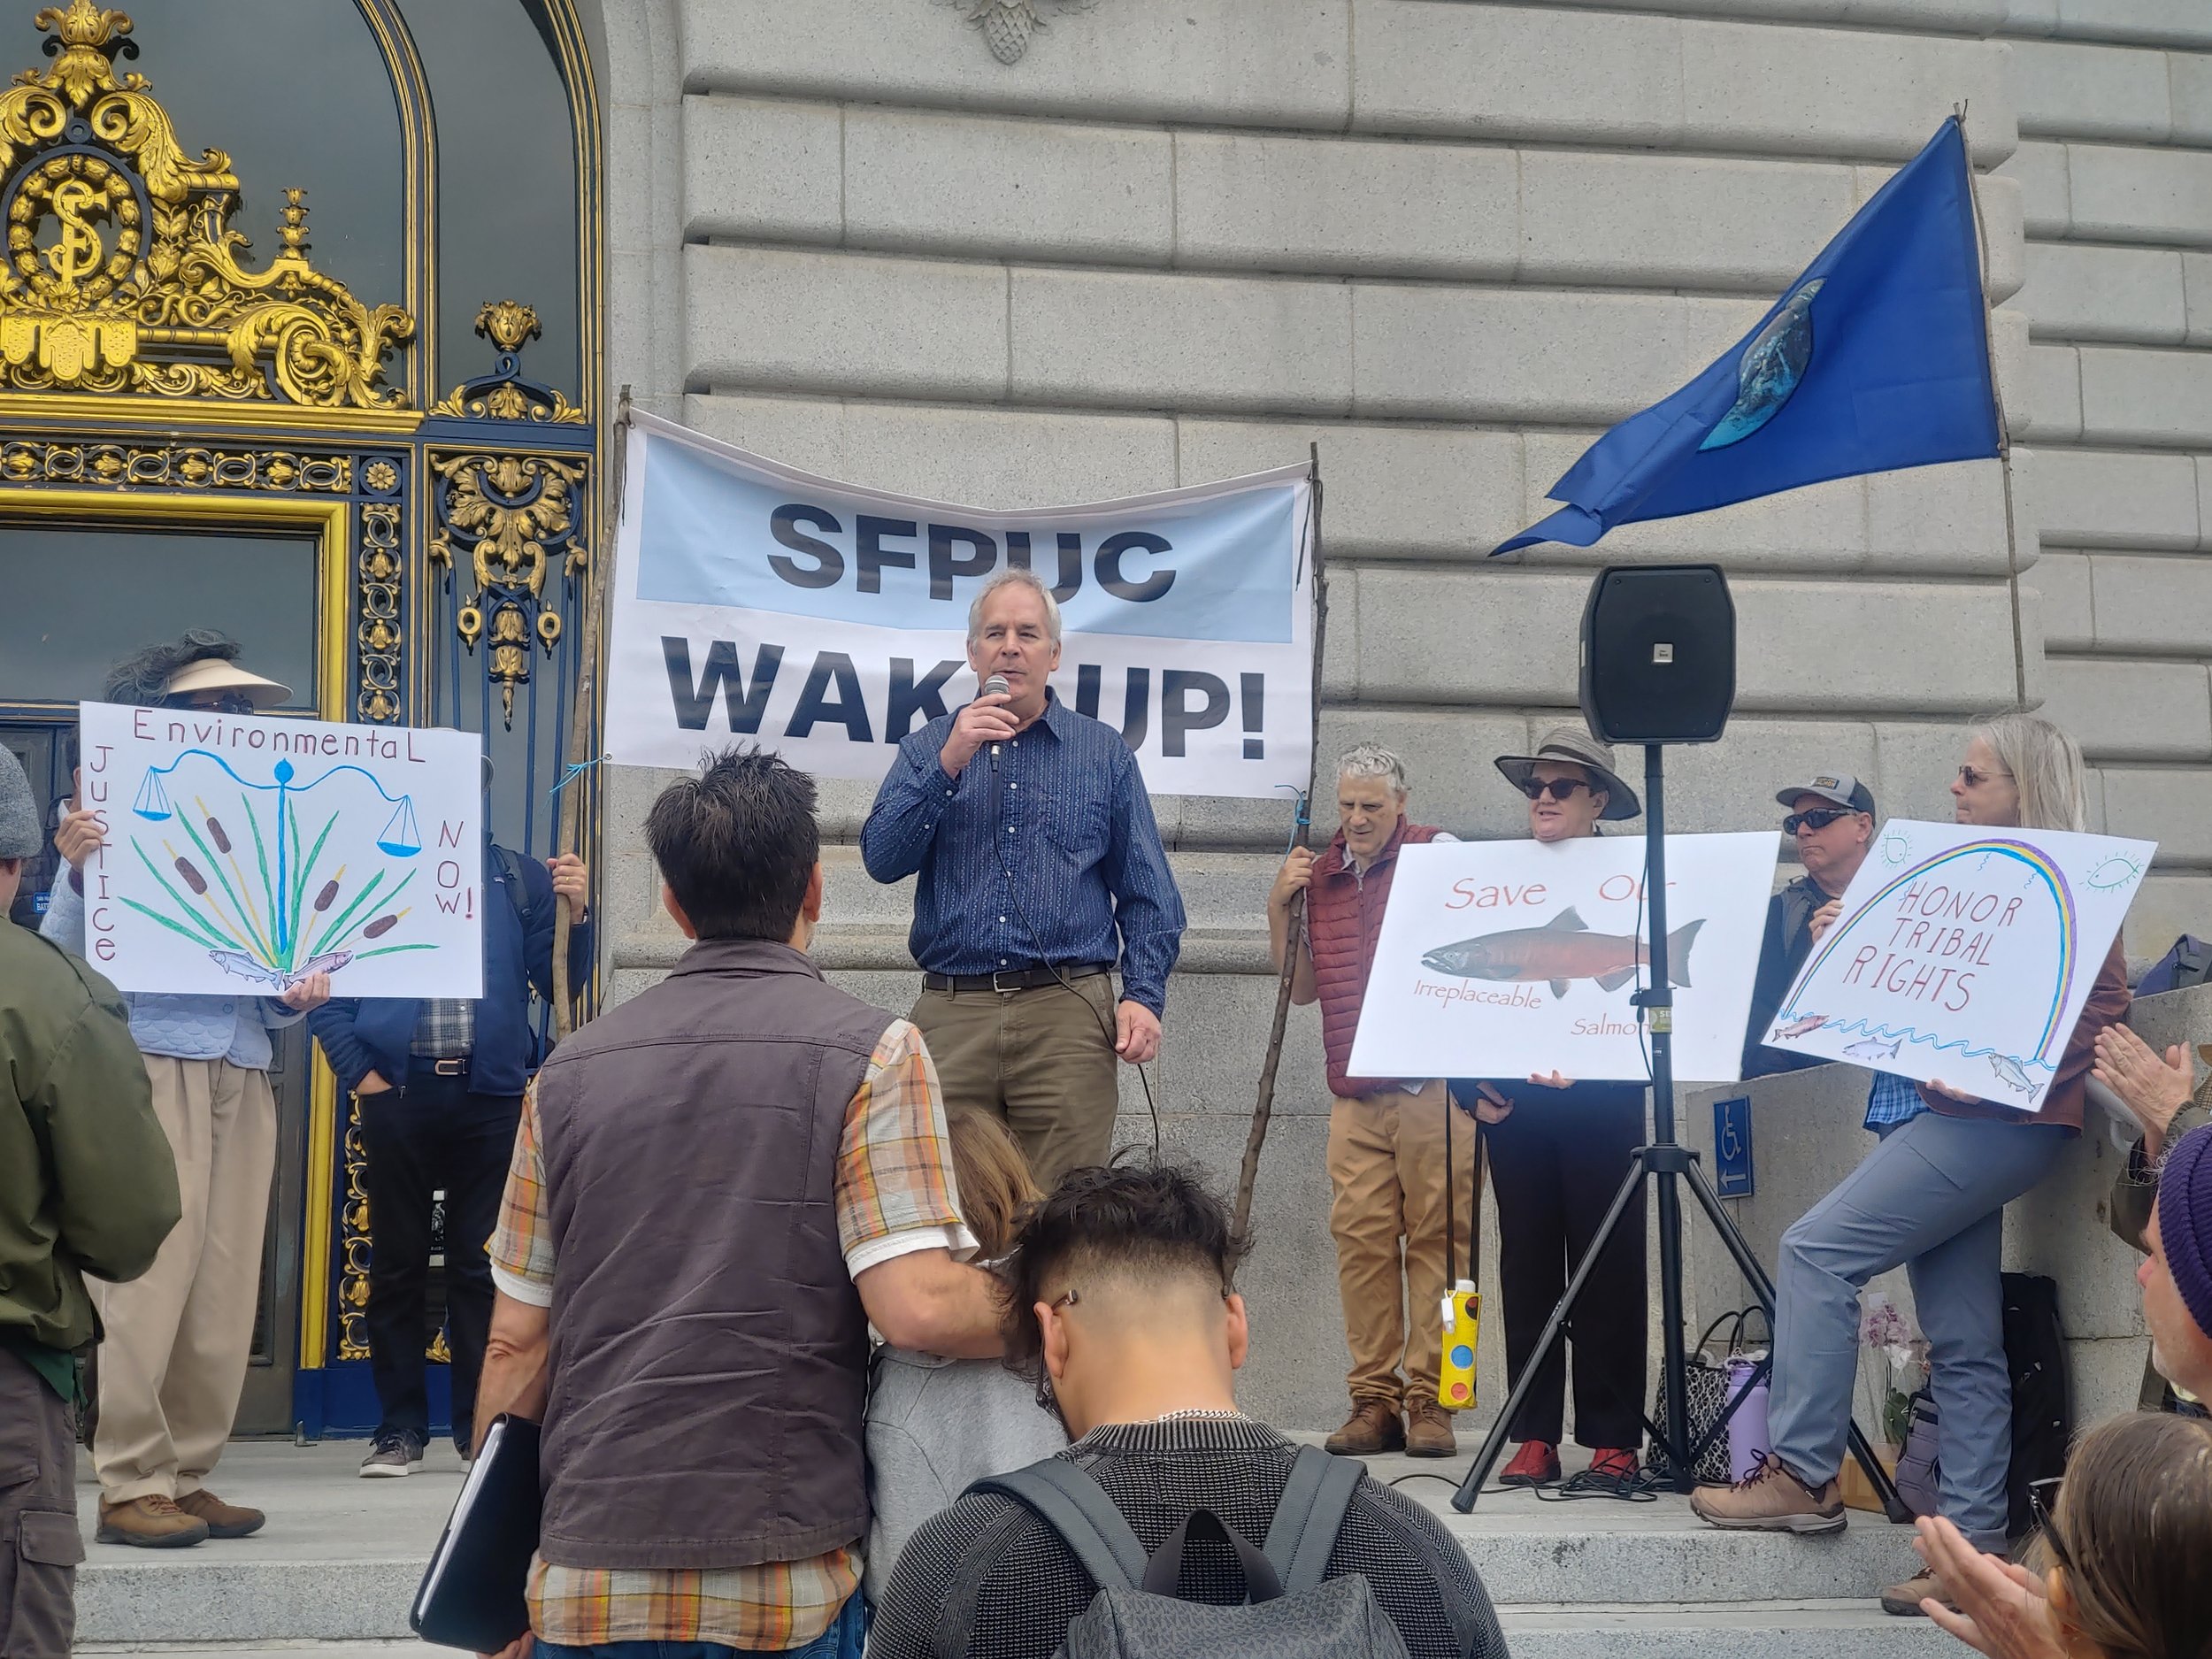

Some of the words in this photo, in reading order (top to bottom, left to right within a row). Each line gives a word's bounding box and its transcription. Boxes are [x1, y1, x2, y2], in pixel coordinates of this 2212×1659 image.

[766, 503, 1177, 605] SFPUC
[660, 635, 967, 744] WAK
[1074, 664, 1264, 760] UP!
[1444, 877, 1547, 910] Save
[1897, 880, 2024, 927] HONOR
[1888, 917, 1994, 966] TRIBAL
[1413, 979, 1542, 1010] Irreplaceable
[1841, 945, 1976, 1011] RIGHTS
